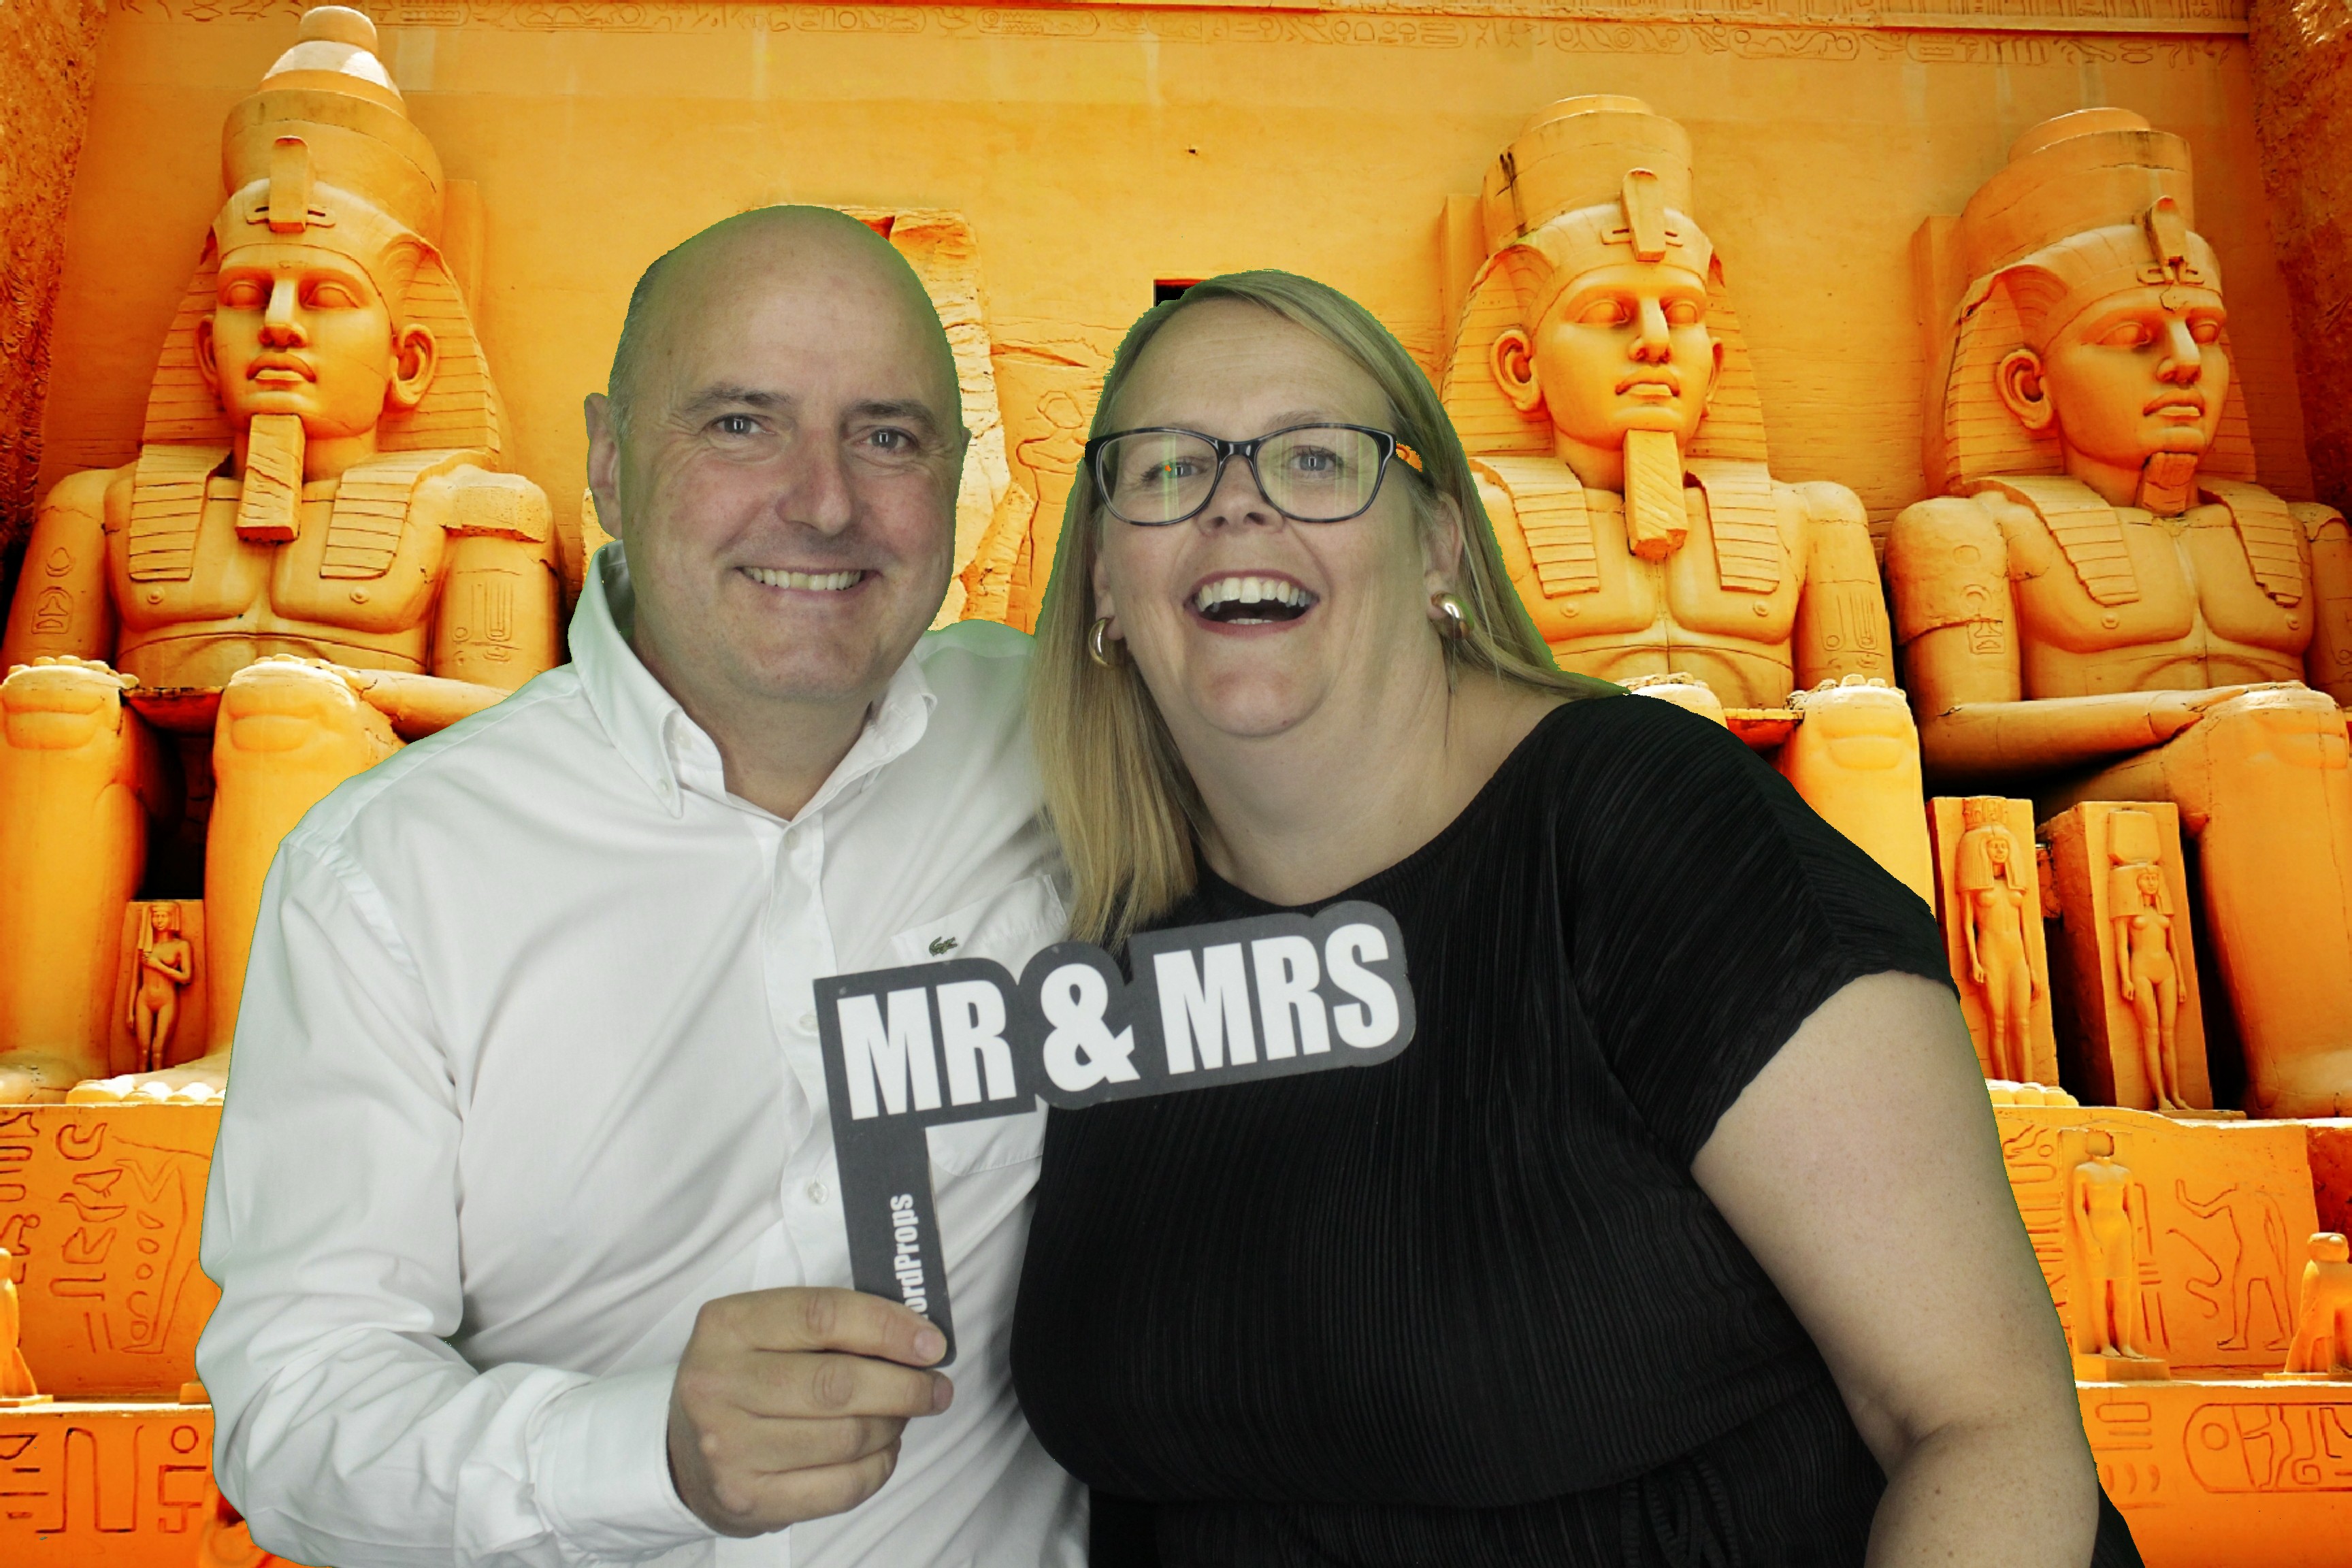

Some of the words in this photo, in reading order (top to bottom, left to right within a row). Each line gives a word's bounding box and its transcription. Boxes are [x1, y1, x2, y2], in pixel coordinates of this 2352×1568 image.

[836, 980, 1017, 1120] MR
[1040, 963, 1141, 1092] &
[1153, 923, 1400, 1075] MRS
[890, 1193, 929, 1321] ordProps
